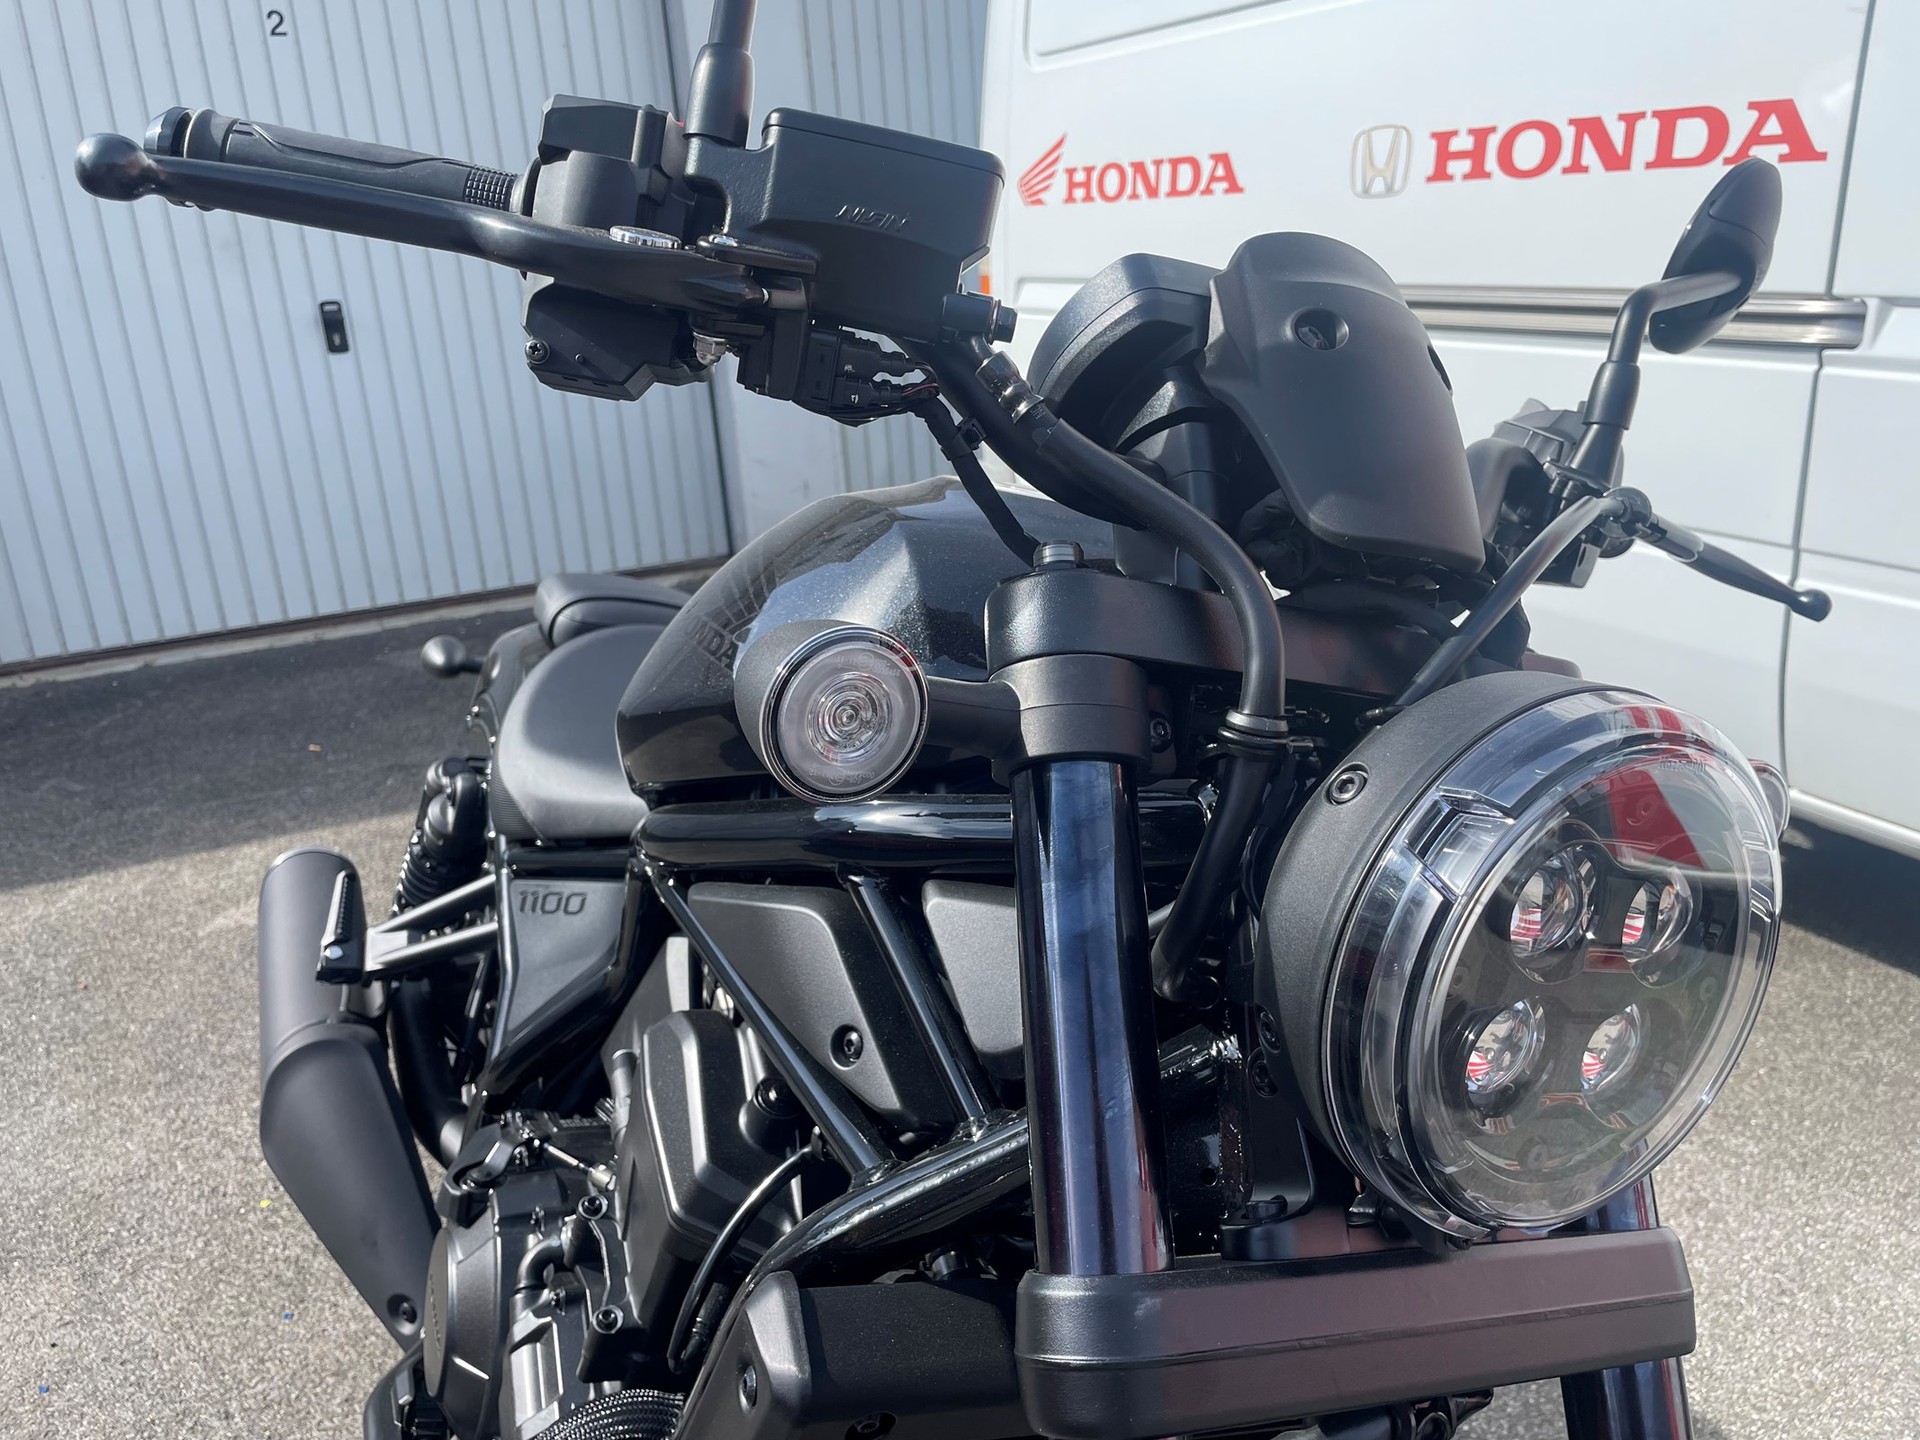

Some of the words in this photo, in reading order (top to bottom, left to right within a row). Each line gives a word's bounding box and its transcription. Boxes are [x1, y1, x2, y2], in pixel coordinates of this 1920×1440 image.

[267, 10, 287, 36] 2
[1425, 98, 1828, 184] HONDA
[1062, 152, 1245, 205] HONDA
[519, 890, 588, 915] 1100
